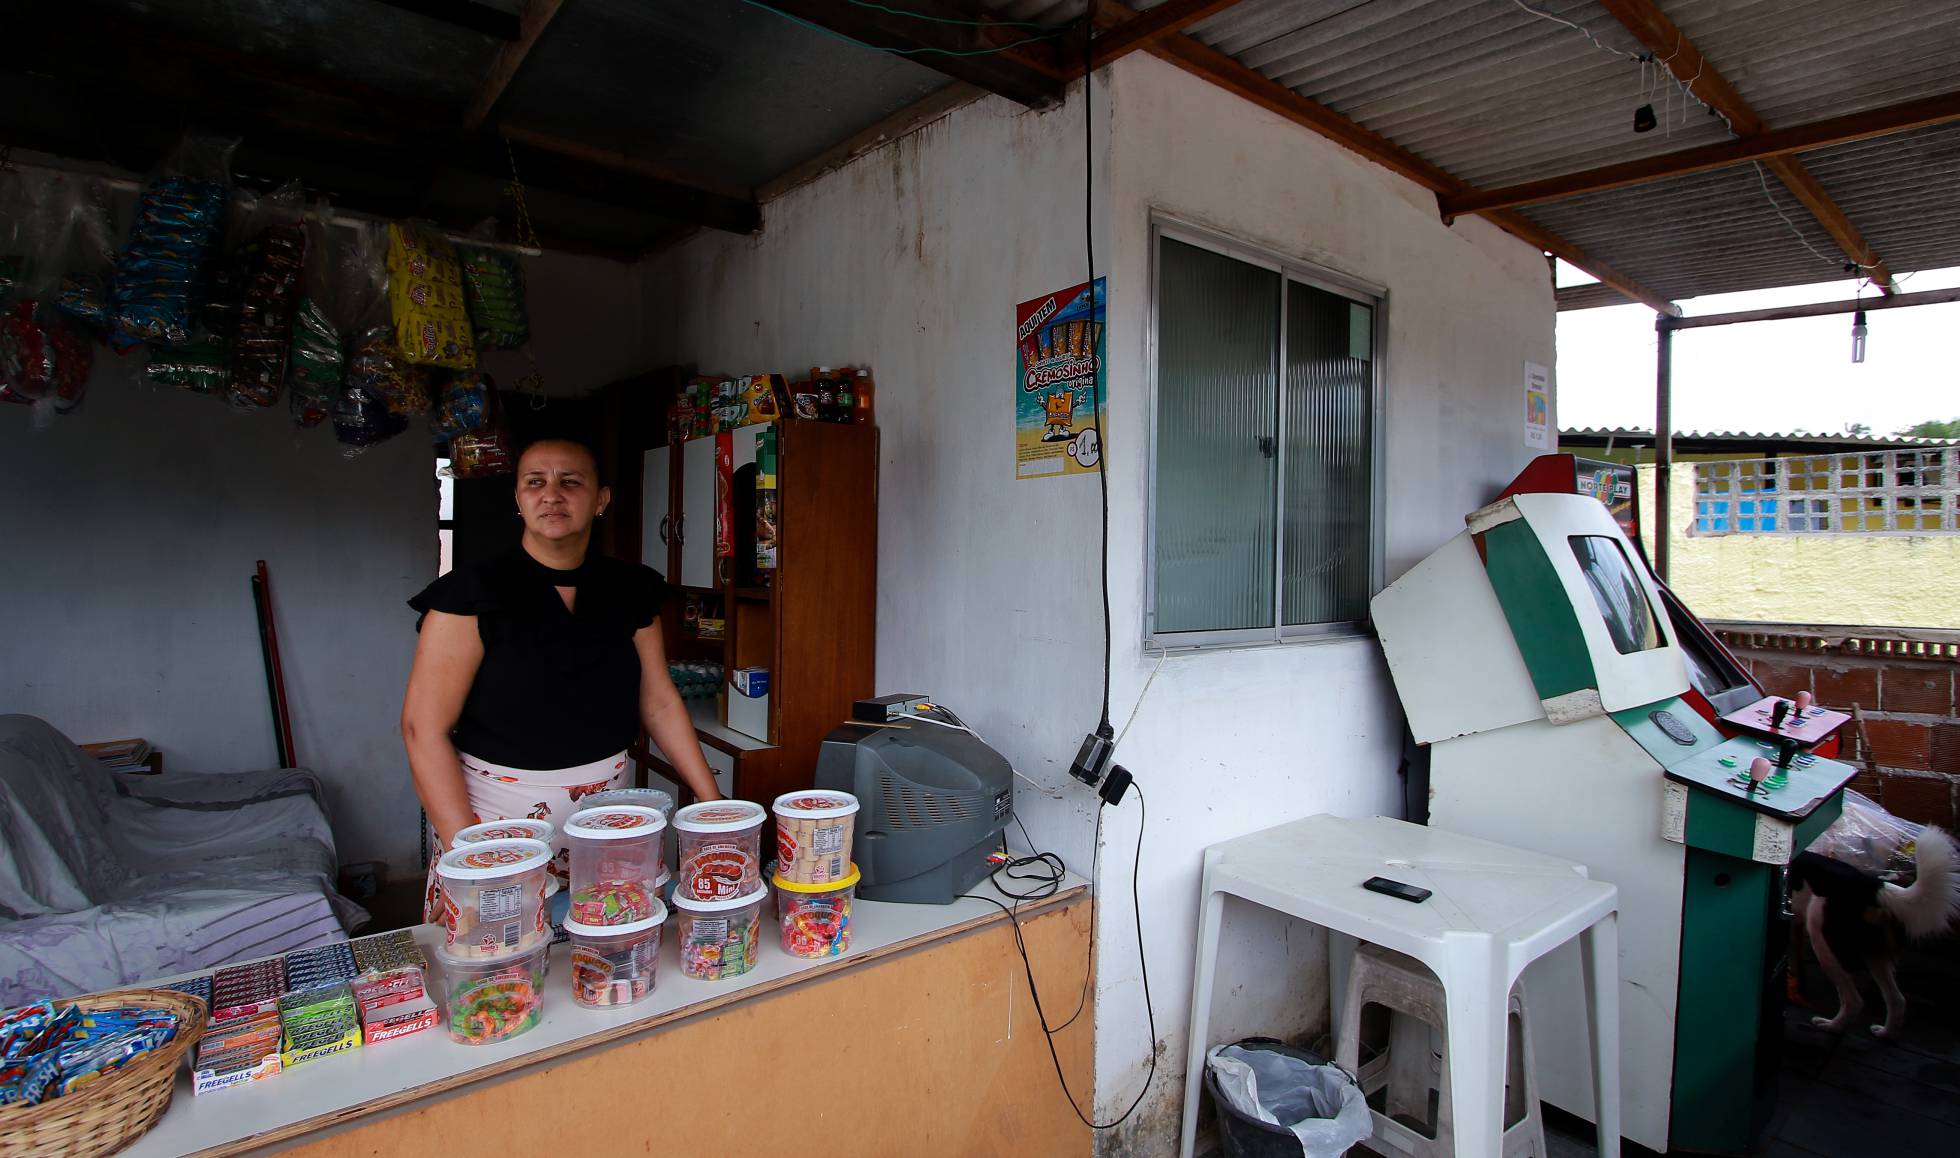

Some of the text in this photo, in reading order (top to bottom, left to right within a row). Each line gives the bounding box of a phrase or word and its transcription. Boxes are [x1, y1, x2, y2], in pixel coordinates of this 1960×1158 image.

[1068, 375, 1096, 390] origina
[1580, 481, 1628, 494] NORTE PLAY
[698, 878, 711, 890] 85
[717, 883, 736, 896] Mini
[372, 1018, 432, 1041] FREEGELLS
[292, 1040, 353, 1063] FREEGELLS
[198, 1071, 252, 1090] FREEGELLS
